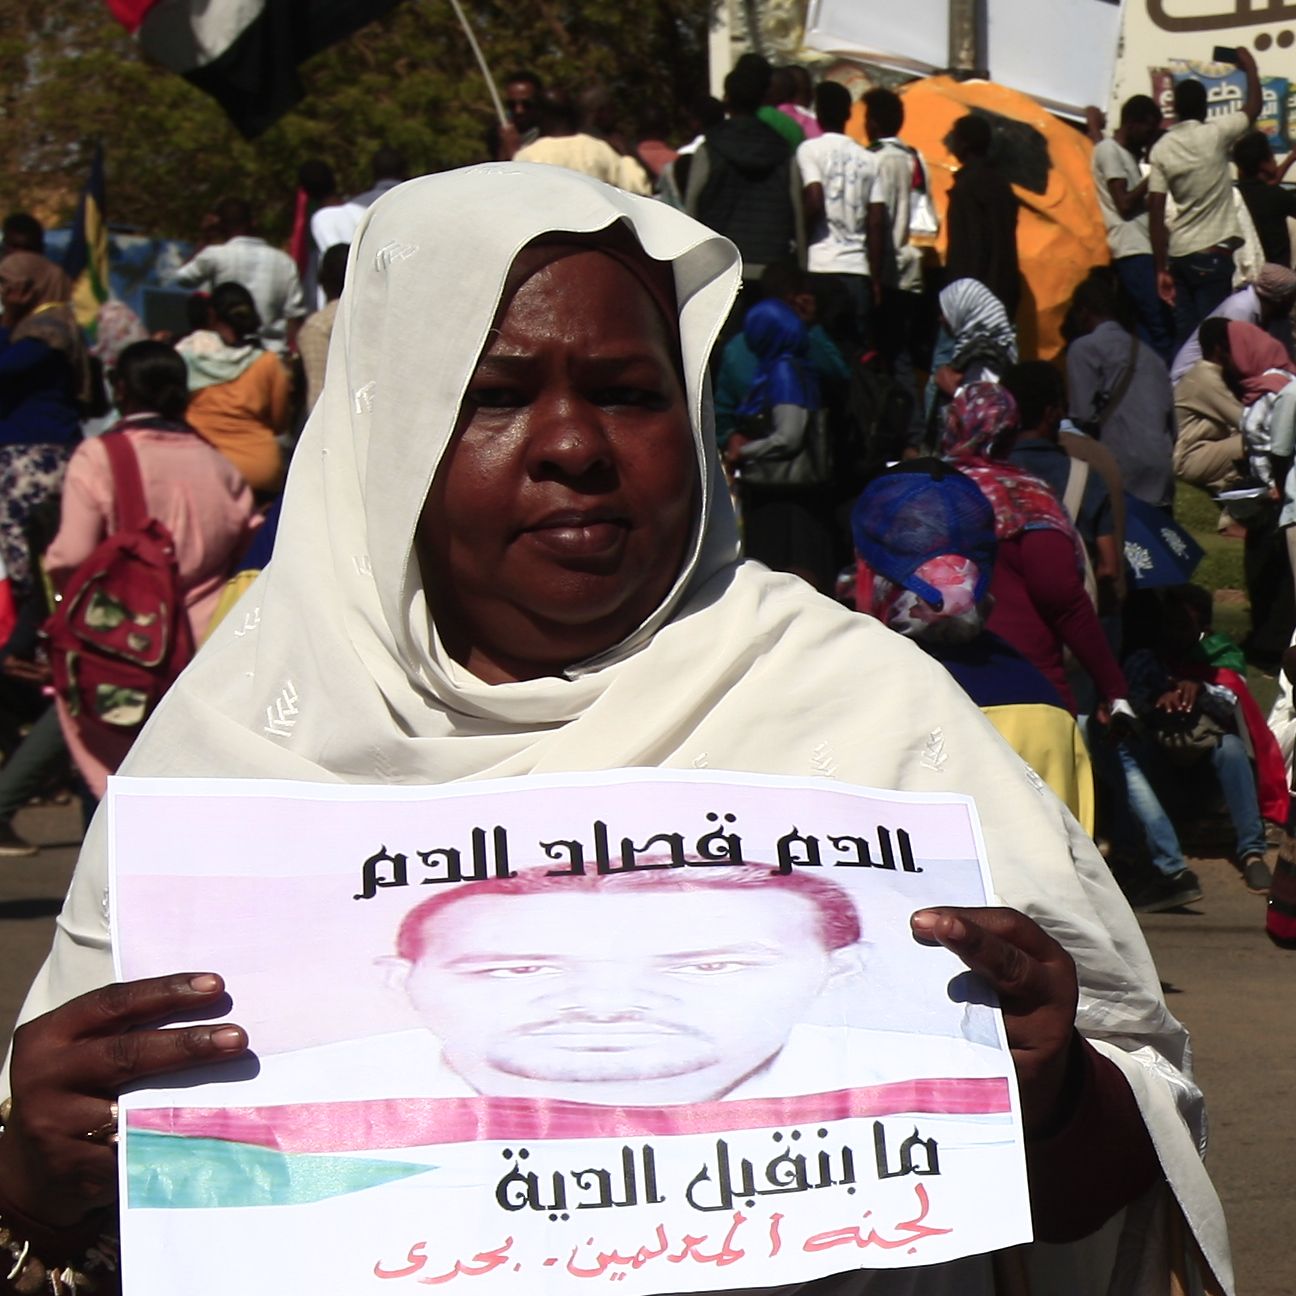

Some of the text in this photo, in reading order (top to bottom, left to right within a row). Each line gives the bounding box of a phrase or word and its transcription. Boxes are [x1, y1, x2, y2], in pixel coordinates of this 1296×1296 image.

[353, 826, 516, 901] الدم
[768, 827, 924, 878] الدم
[495, 1120, 941, 1222] ما بنقبل الدية
